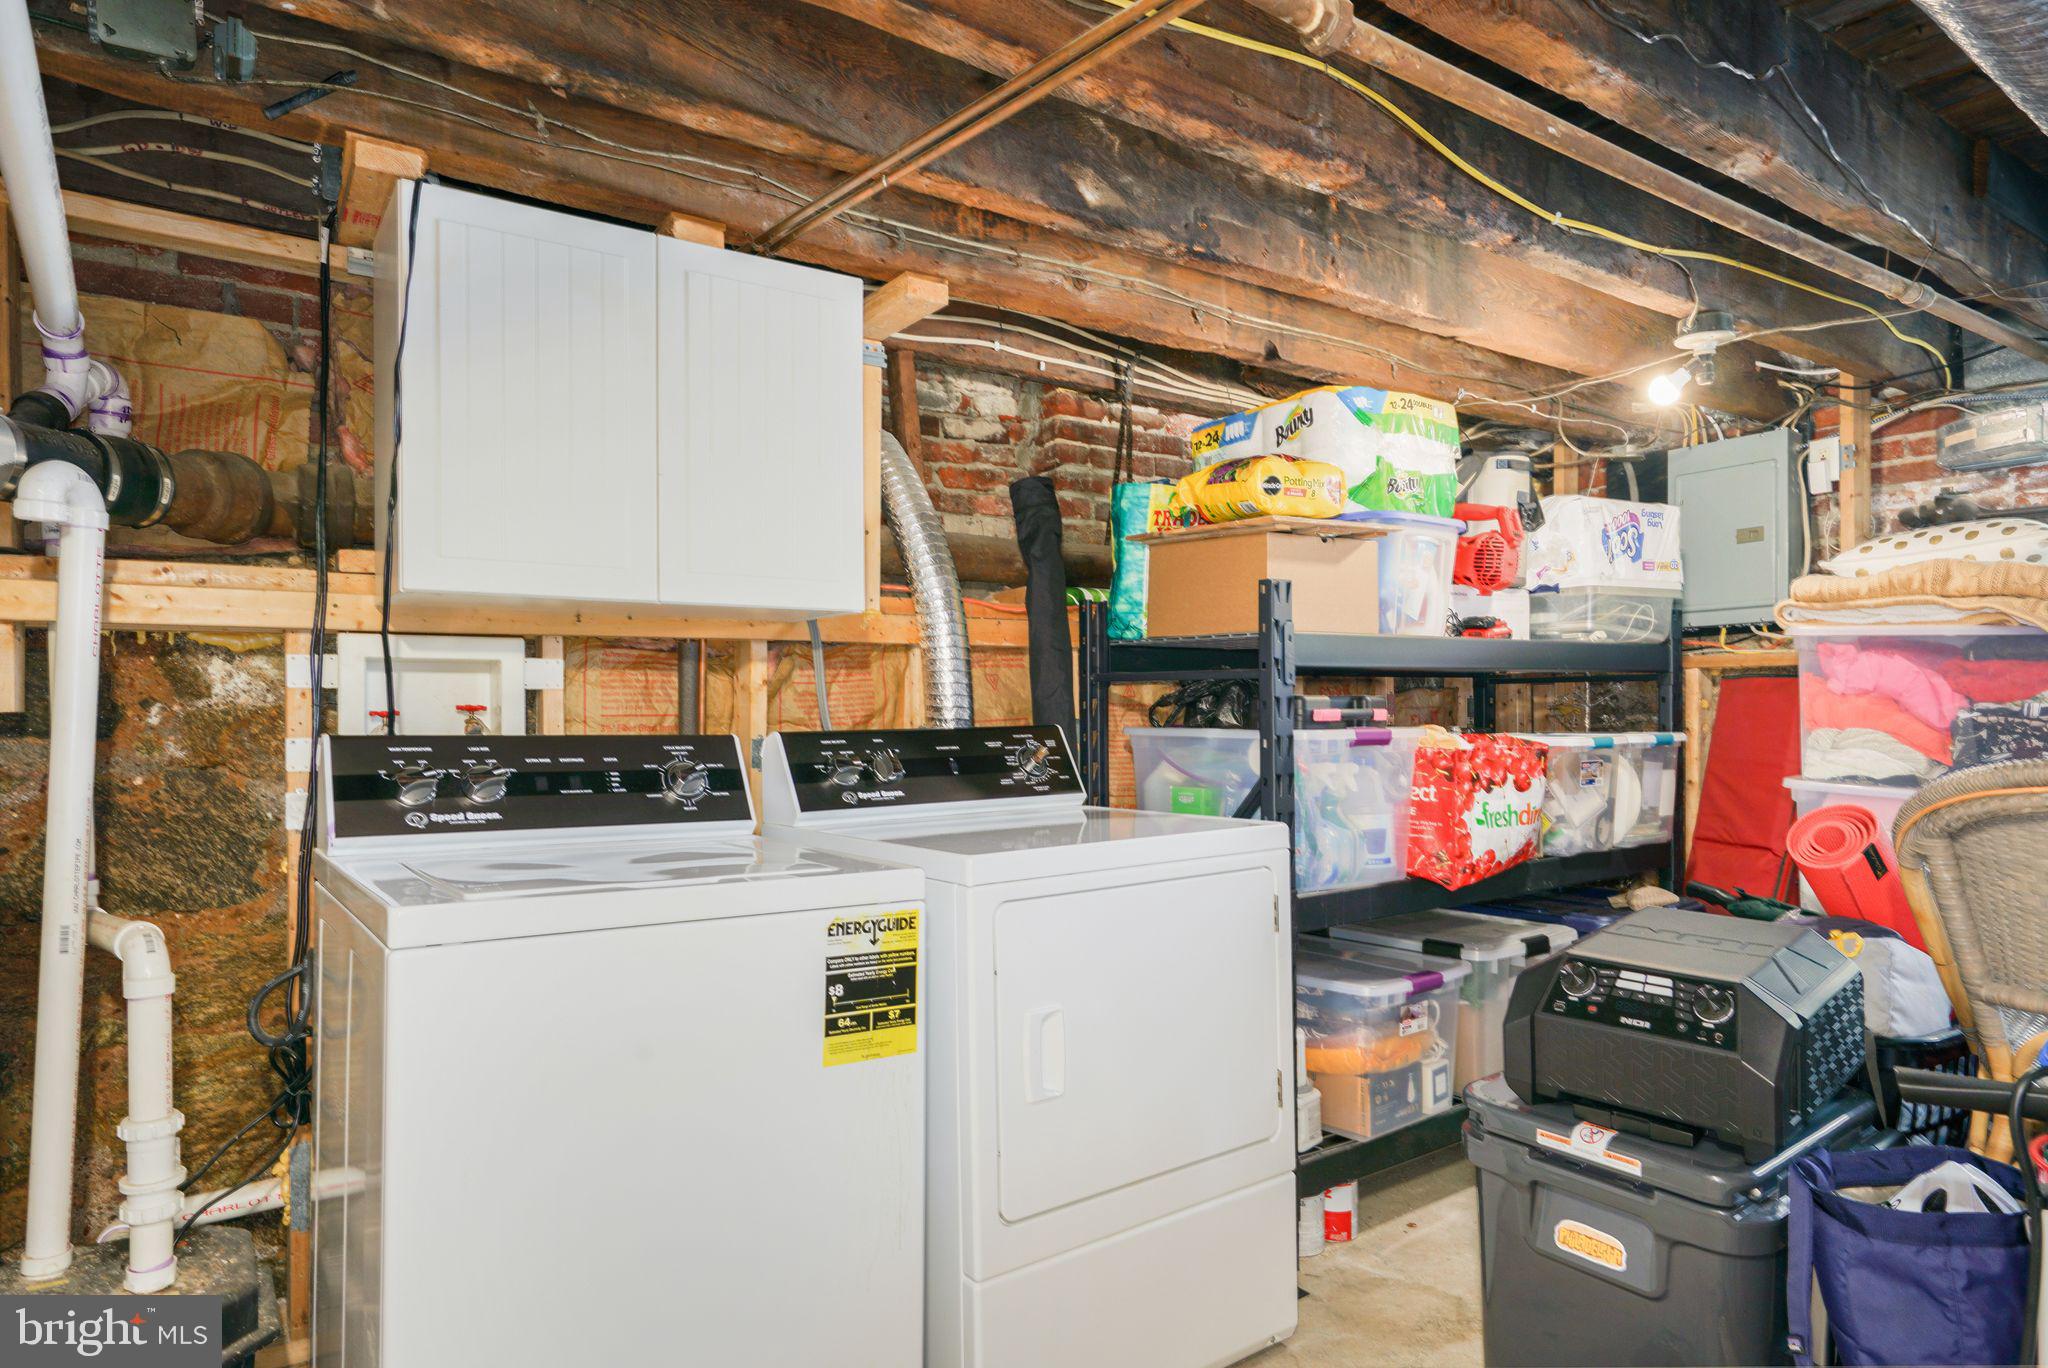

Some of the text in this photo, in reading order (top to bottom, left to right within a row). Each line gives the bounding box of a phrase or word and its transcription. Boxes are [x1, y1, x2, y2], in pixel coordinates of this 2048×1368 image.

[1275, 407, 1314, 448] Bounty
[1284, 475, 1313, 490] Potting
[429, 812, 465, 823] Speed
[828, 984, 844, 997] $8
[888, 1009, 901, 1020] $7
